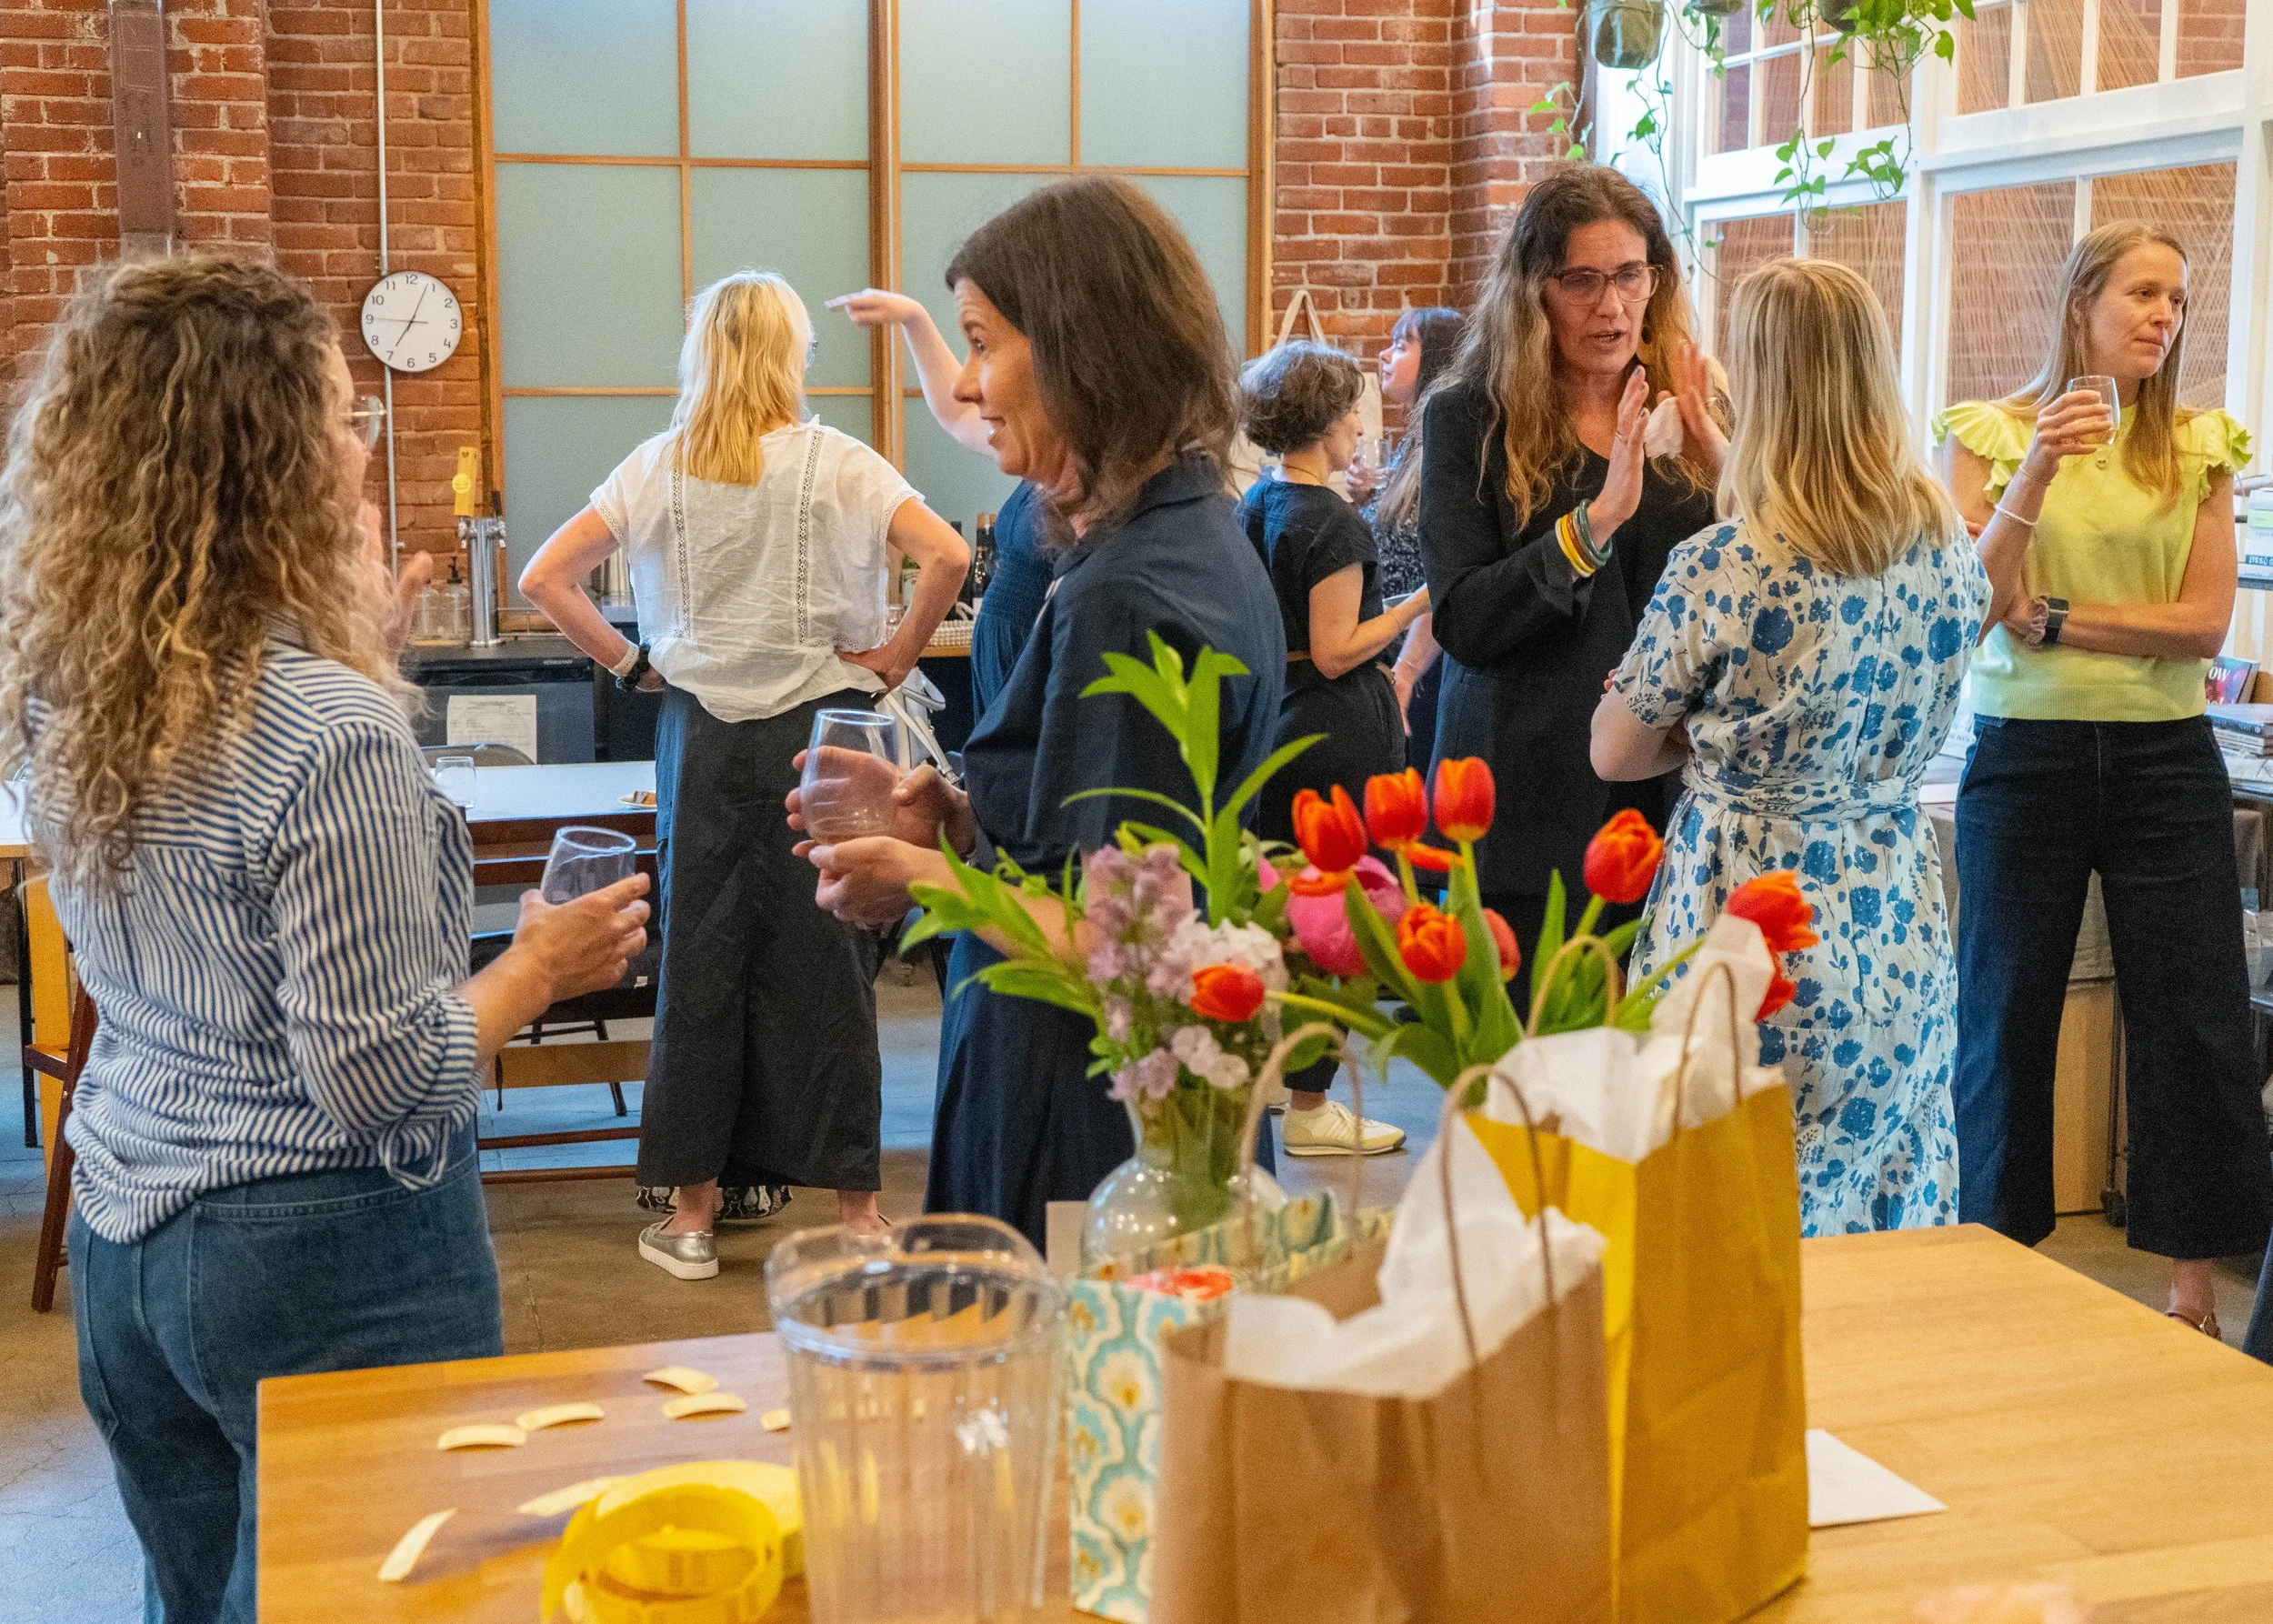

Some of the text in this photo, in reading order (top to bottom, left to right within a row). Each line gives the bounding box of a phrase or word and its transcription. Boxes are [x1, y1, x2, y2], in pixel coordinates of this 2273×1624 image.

[386, 280, 396, 290] 11
[406, 275, 418, 285] 12
[432, 283, 436, 293] 1
[372, 295, 385, 306] 10
[445, 297, 453, 308] 2
[365, 315, 375, 325] 9
[450, 319, 458, 329] 3
[371, 336, 379, 346] 8
[444, 338, 451, 348] 4
[386, 351, 394, 361] 7
[428, 353, 436, 363] 5
[406, 358, 416, 368] 6
